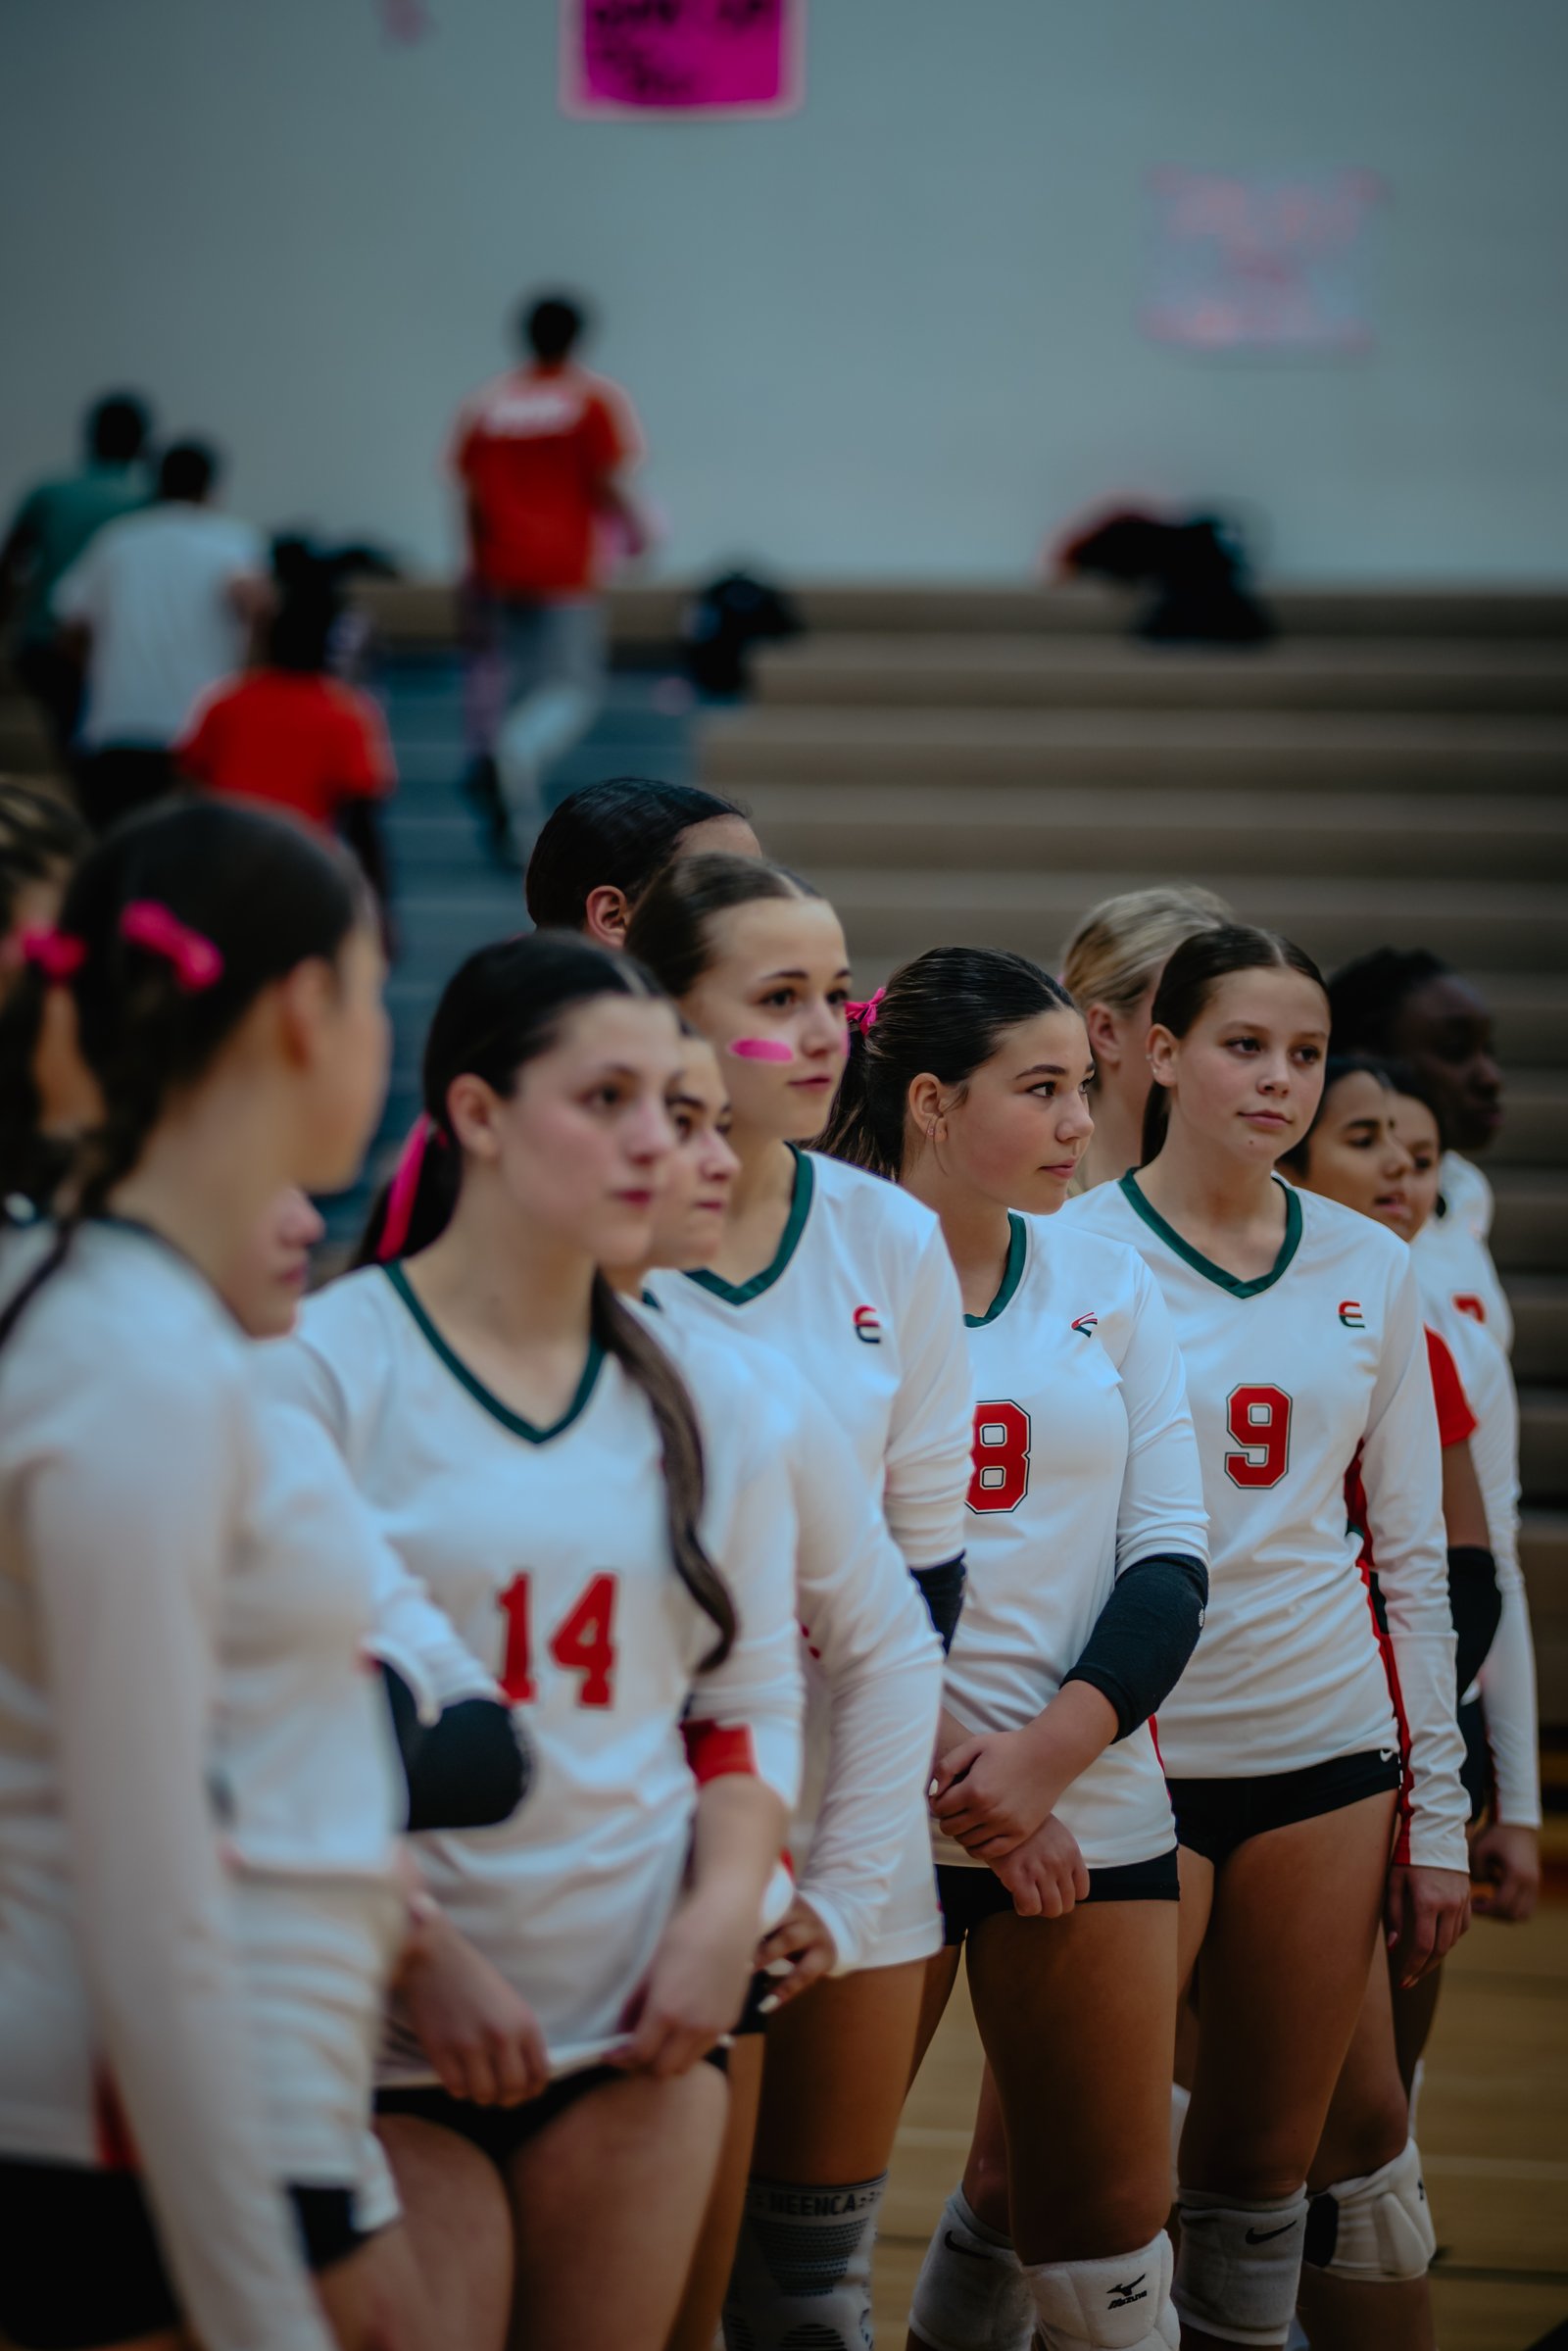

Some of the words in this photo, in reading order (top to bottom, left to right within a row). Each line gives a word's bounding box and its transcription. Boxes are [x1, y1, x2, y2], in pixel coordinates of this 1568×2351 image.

[964, 1399, 1031, 1514] 8
[1225, 1383, 1293, 1489] 9
[497, 1571, 616, 1709] 14
